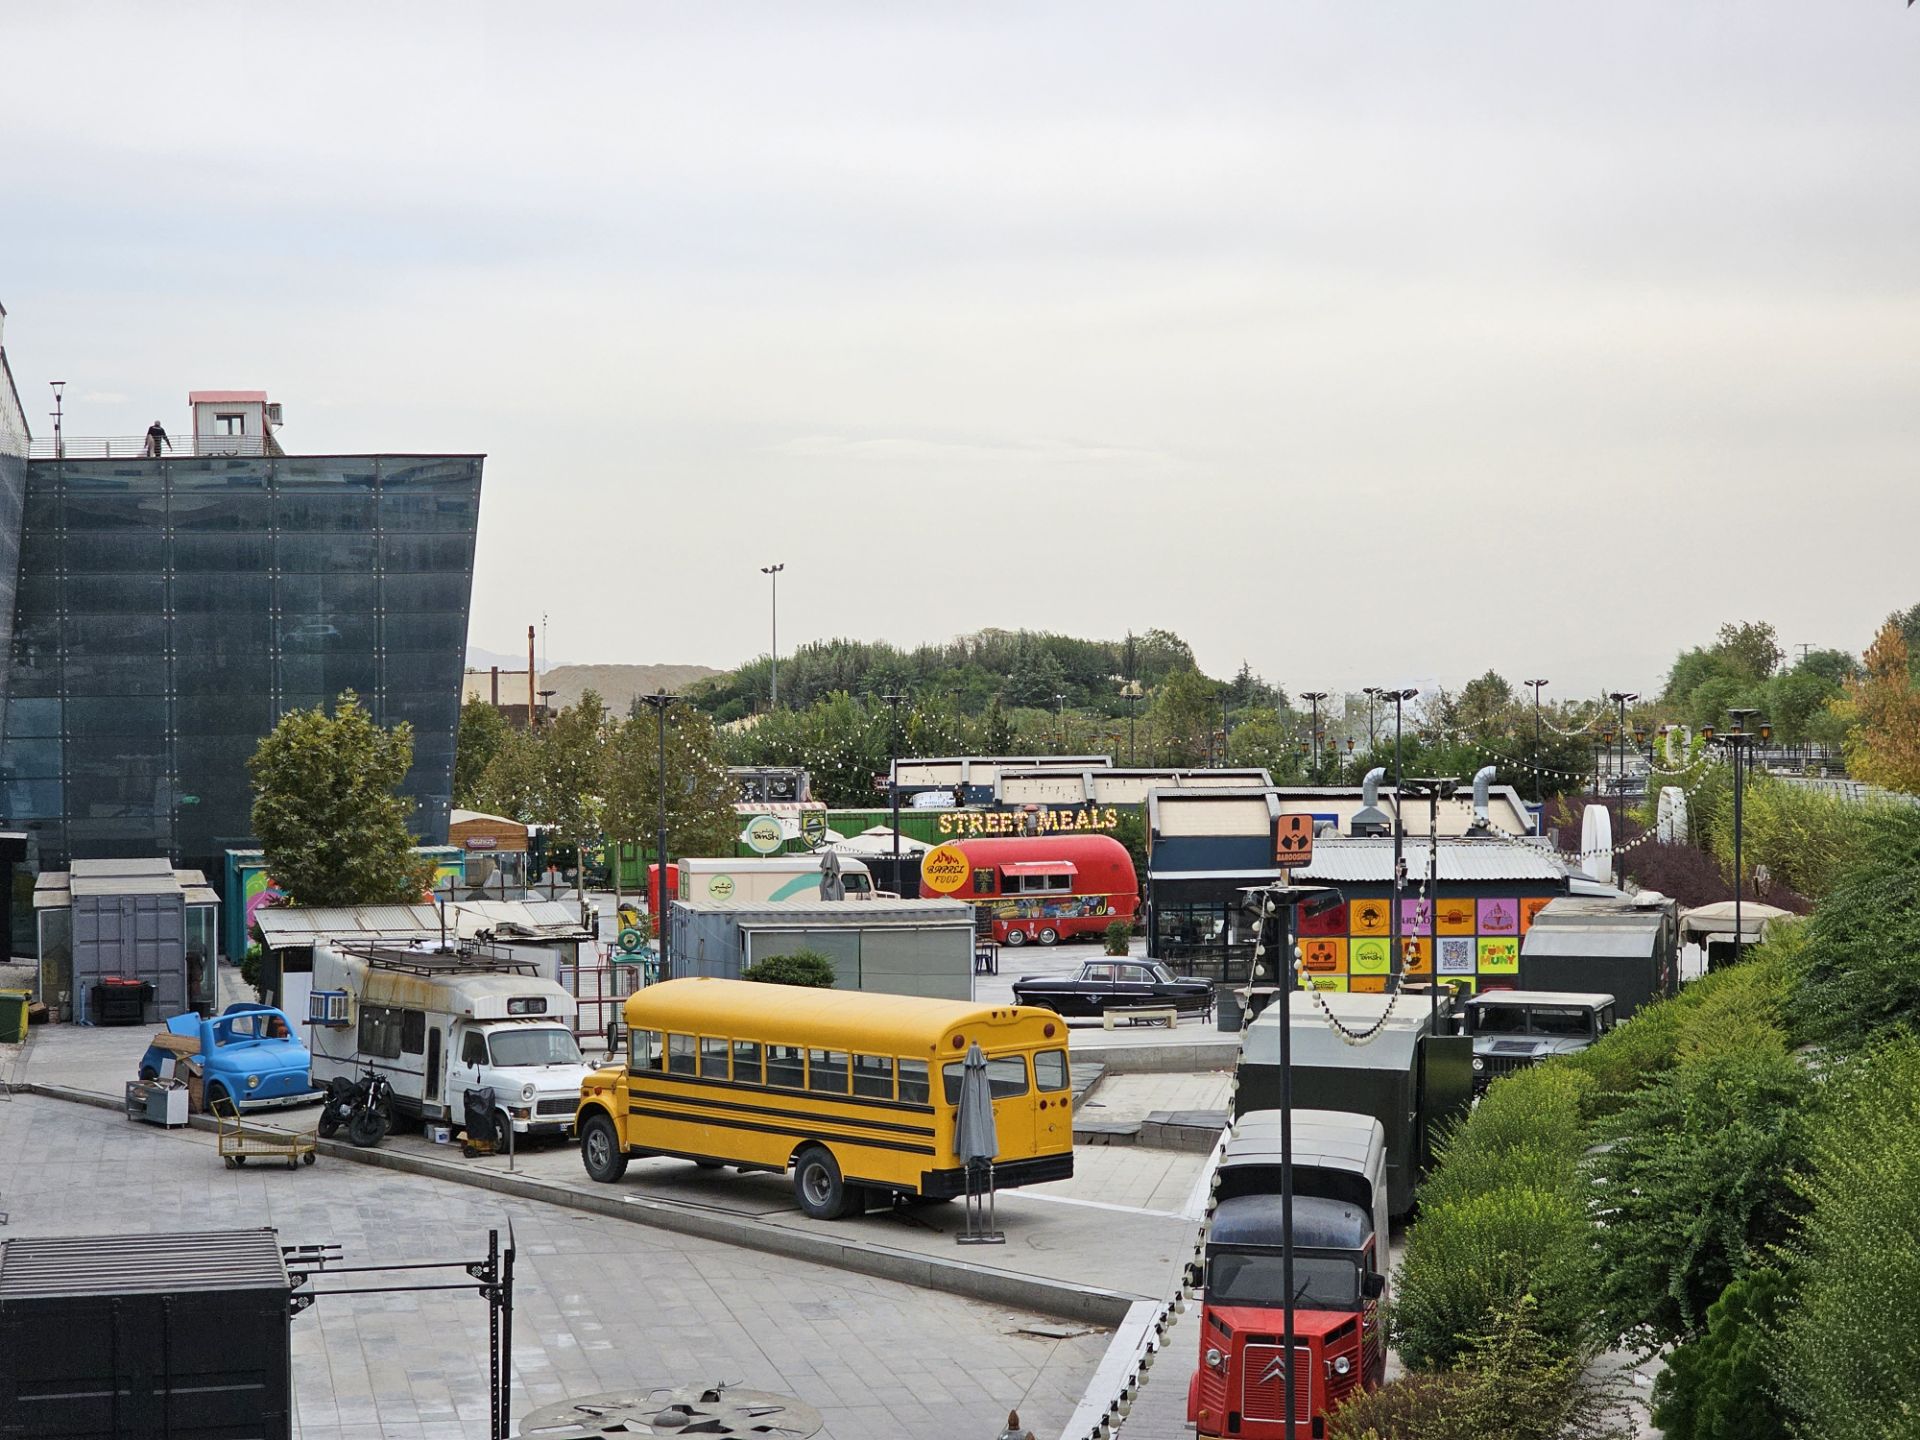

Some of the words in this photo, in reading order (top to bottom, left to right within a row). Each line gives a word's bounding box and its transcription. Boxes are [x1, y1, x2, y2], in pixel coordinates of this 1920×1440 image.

[939, 812, 1027, 834] STREET
[1036, 808, 1118, 832] MEALS
[935, 875, 958, 884] FOOD
[1481, 955, 1515, 965] MUNY
